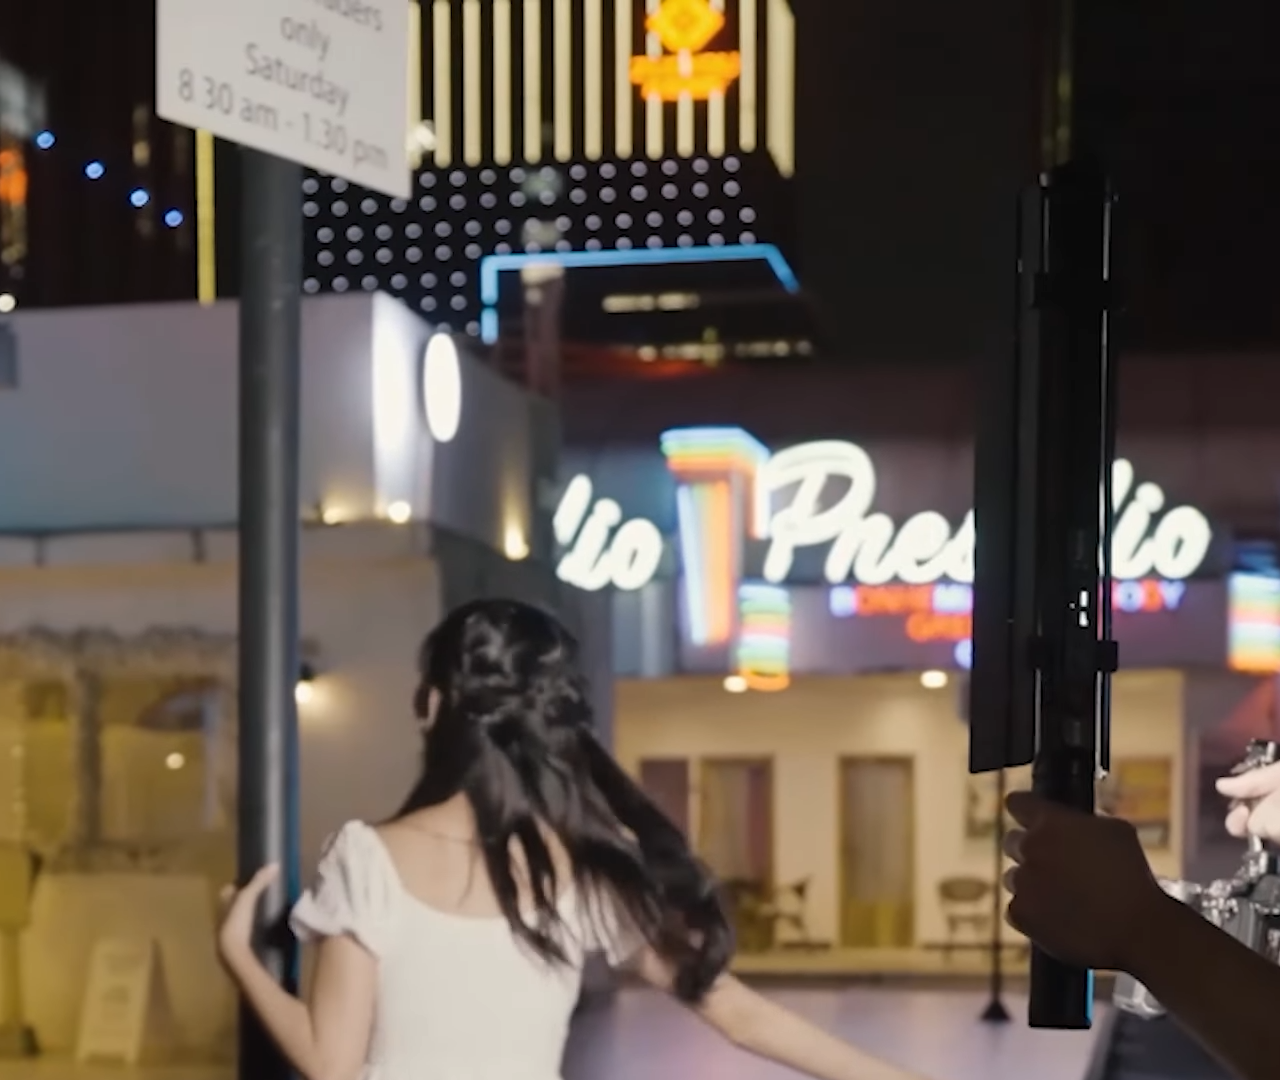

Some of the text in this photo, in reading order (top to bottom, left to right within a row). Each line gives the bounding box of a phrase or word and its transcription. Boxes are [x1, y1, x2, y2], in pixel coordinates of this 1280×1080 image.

[280, 16, 331, 61] only
[245, 42, 350, 117] Saturday
[239, 97, 279, 131] am
[353, 139, 389, 170] pm
